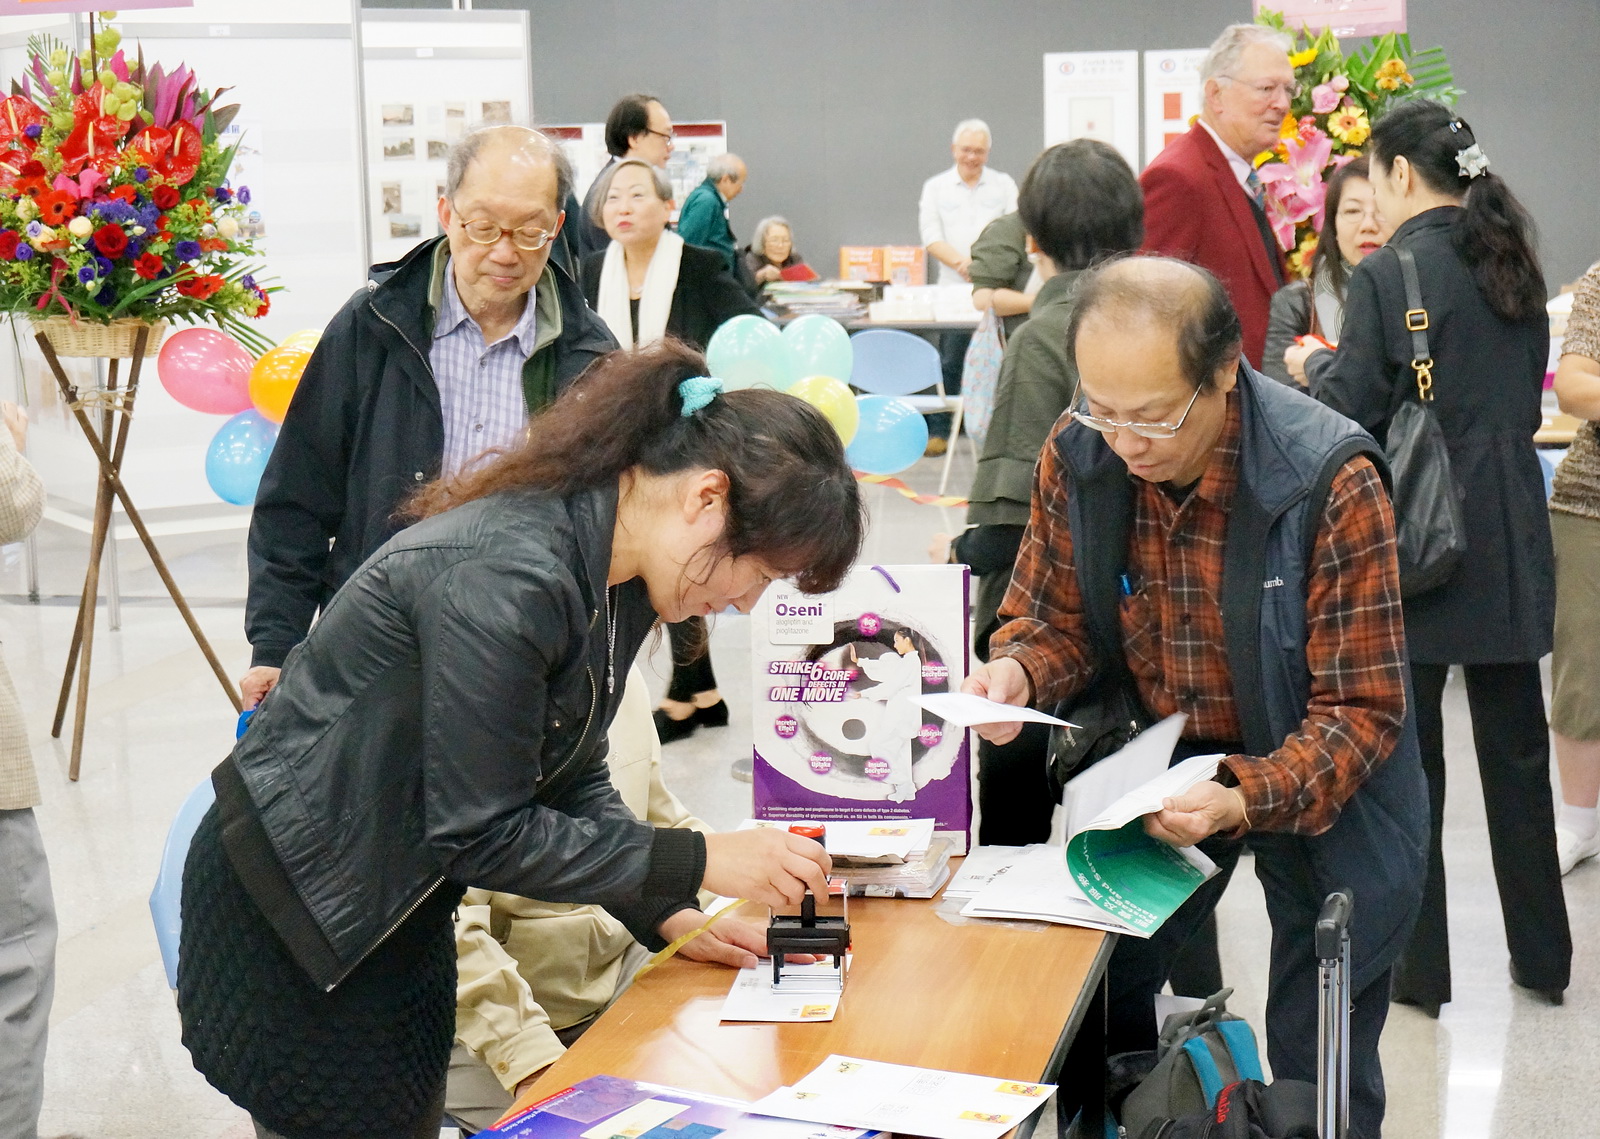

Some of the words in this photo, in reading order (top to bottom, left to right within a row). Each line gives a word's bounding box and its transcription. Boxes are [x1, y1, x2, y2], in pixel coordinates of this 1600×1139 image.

[775, 602, 823, 617] Oseni
[776, 627, 809, 636] pioglitazone
[770, 661, 813, 674] STRIKE
[810, 662, 825, 681] 6
[822, 670, 851, 680] CORE
[770, 687, 800, 701] ONE
[918, 730, 943, 738] Lipolysis
[811, 761, 831, 769] Uptake
[1101, 881, 1123, 900] and
[1108, 894, 1153, 925] Postage
[1124, 899, 1158, 921] Rates
